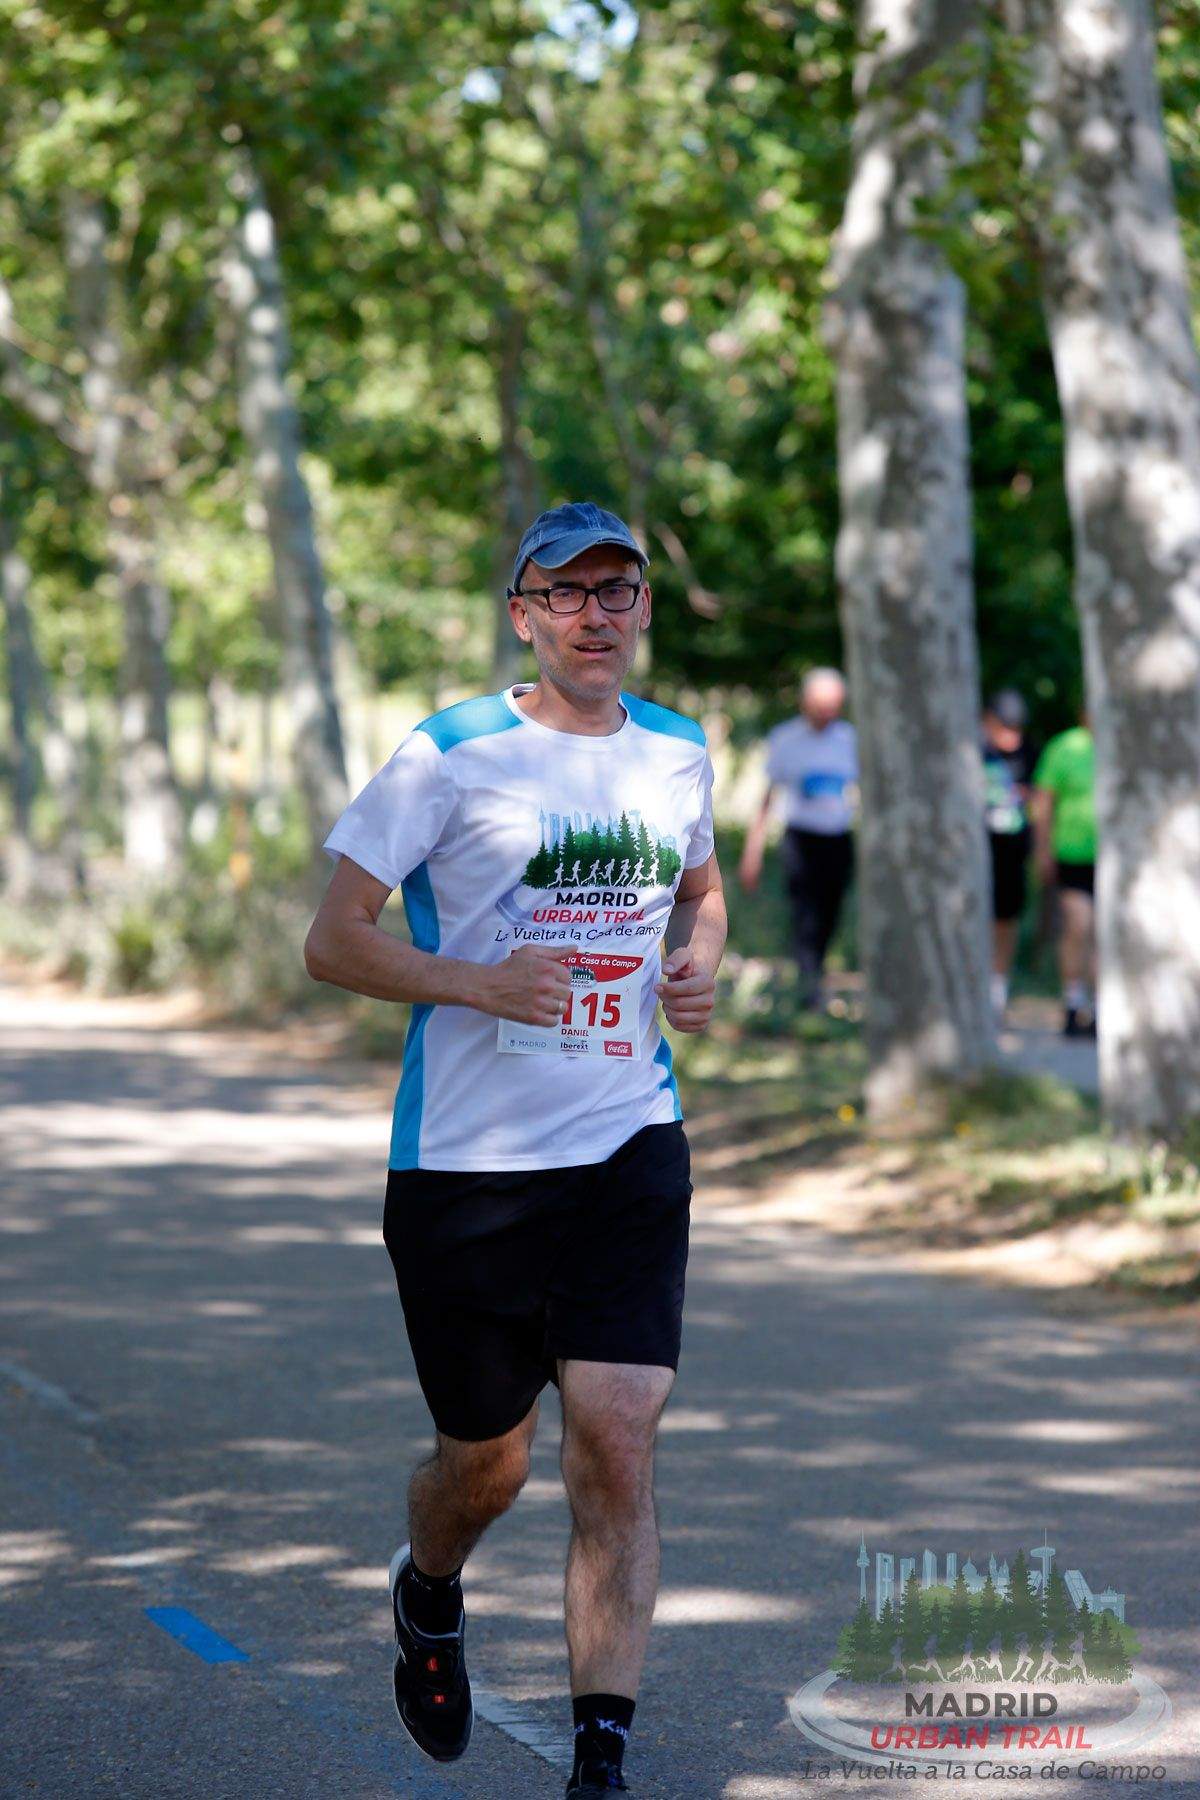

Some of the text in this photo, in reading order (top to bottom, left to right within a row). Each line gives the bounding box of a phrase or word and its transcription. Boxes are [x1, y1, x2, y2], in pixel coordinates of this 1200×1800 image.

[555, 891, 638, 907] MADRID
[532, 909, 598, 924] URBAN
[513, 927, 557, 941] Vuelta
[558, 930, 567, 940] a
[570, 928, 582, 941] la
[615, 925, 632, 936] de
[580, 956, 600, 965] Casa
[600, 958, 611, 966] de
[611, 959, 638, 969] Campo
[561, 1028, 589, 1037] DANIEL
[518, 1040, 547, 1048] MADRID
